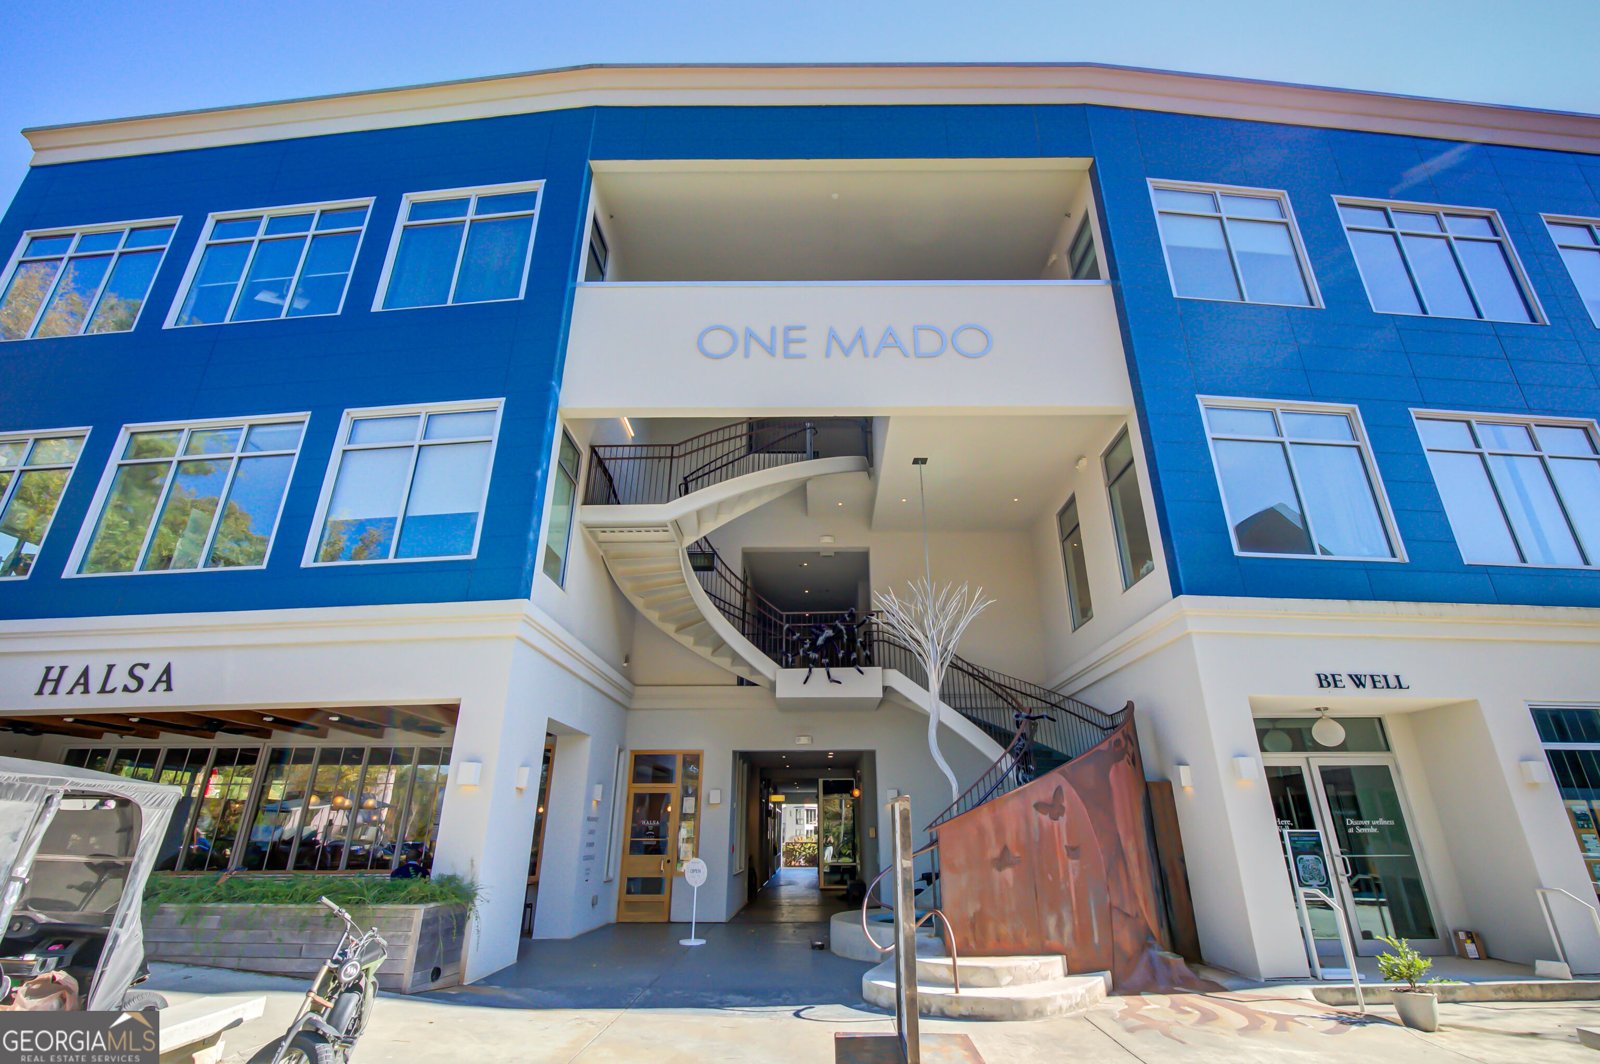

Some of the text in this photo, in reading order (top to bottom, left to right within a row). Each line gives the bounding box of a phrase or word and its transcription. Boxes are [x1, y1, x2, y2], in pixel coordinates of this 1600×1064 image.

[697, 323, 993, 359] ONE MADO
[34, 661, 173, 696] HALSA
[1315, 673, 1410, 690] BE WELL
